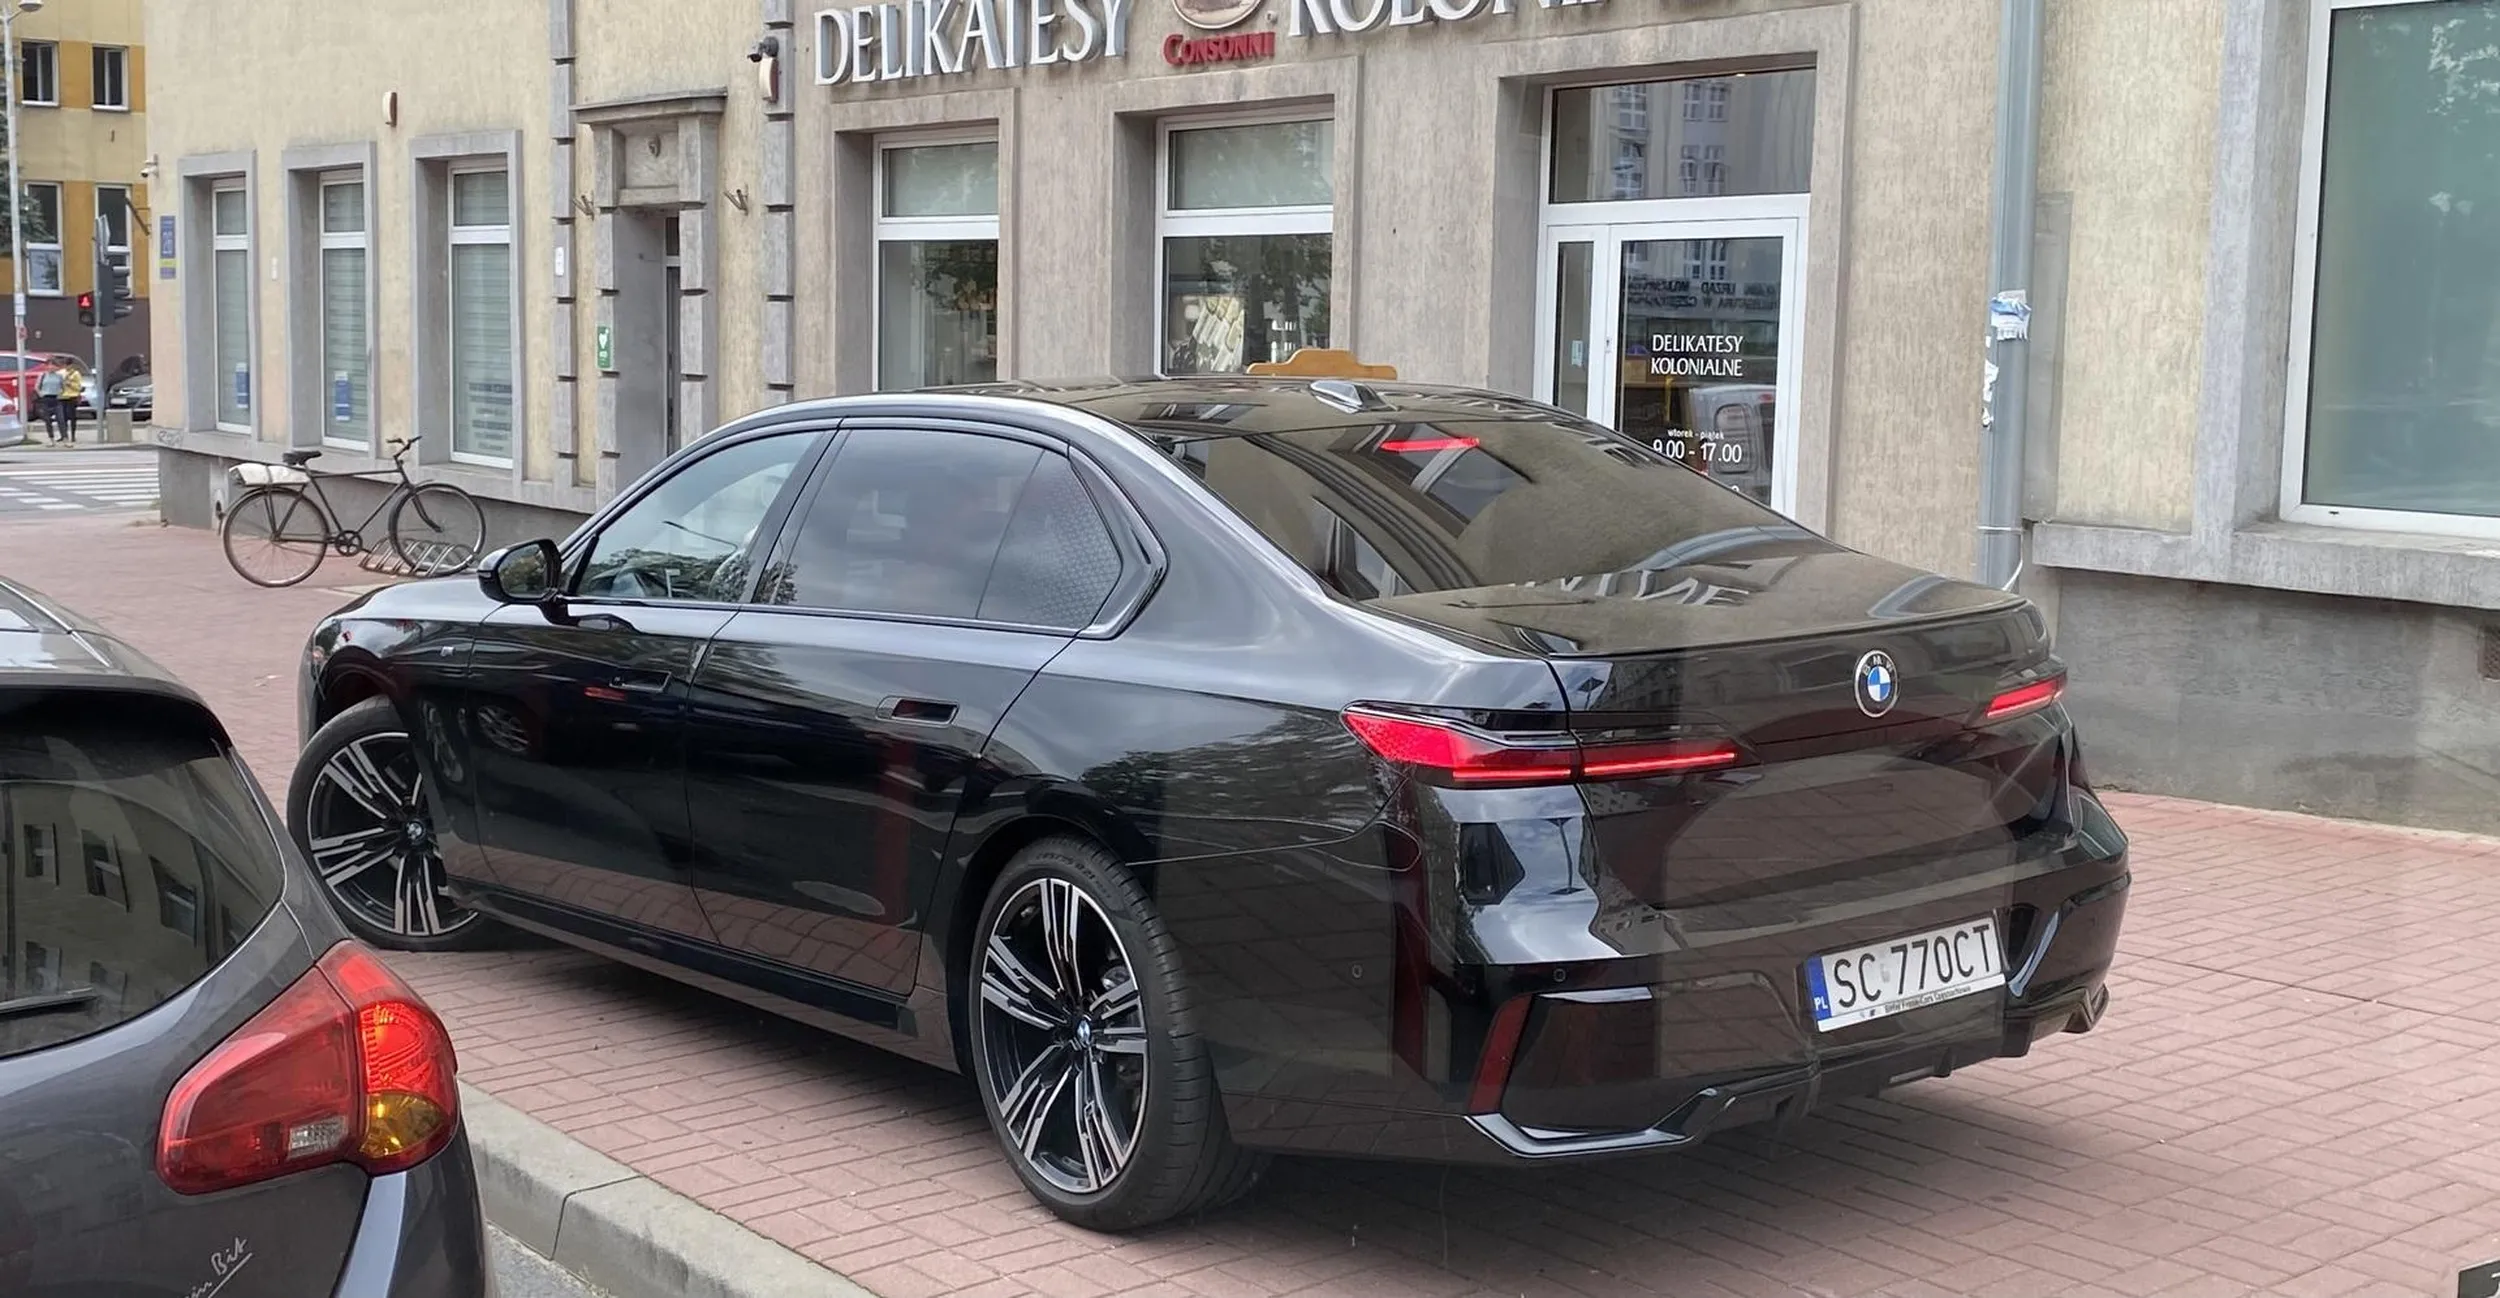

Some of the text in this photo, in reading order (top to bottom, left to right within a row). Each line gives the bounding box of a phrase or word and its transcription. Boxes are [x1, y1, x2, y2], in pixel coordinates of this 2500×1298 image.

[814, 0, 1130, 86] DELIKATESY
[1652, 334, 1743, 353] DELIKATESY
[1651, 357, 1743, 376] KOLONIALNE
[1667, 428, 1694, 438] wtorek
[1700, 442, 1742, 463] 17.00
[1862, 655, 1893, 676] BMW
[1833, 924, 1990, 1008] SC 770CT
[1814, 996, 1829, 1012] PL
